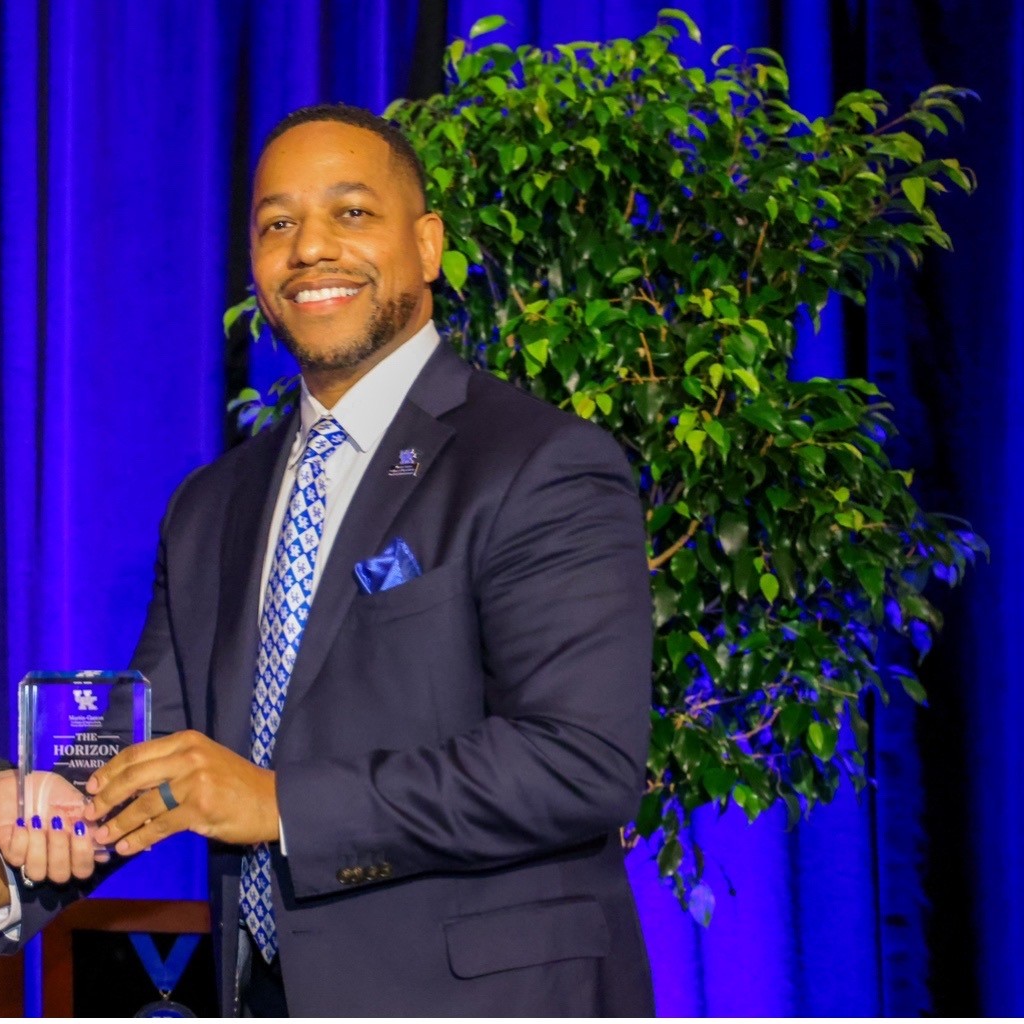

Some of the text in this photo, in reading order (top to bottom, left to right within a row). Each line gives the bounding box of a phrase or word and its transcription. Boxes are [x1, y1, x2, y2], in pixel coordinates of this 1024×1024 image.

[75, 732, 98, 742] THE
[53, 744, 120, 757] HORIZON
[68, 759, 105, 769] AWARD
